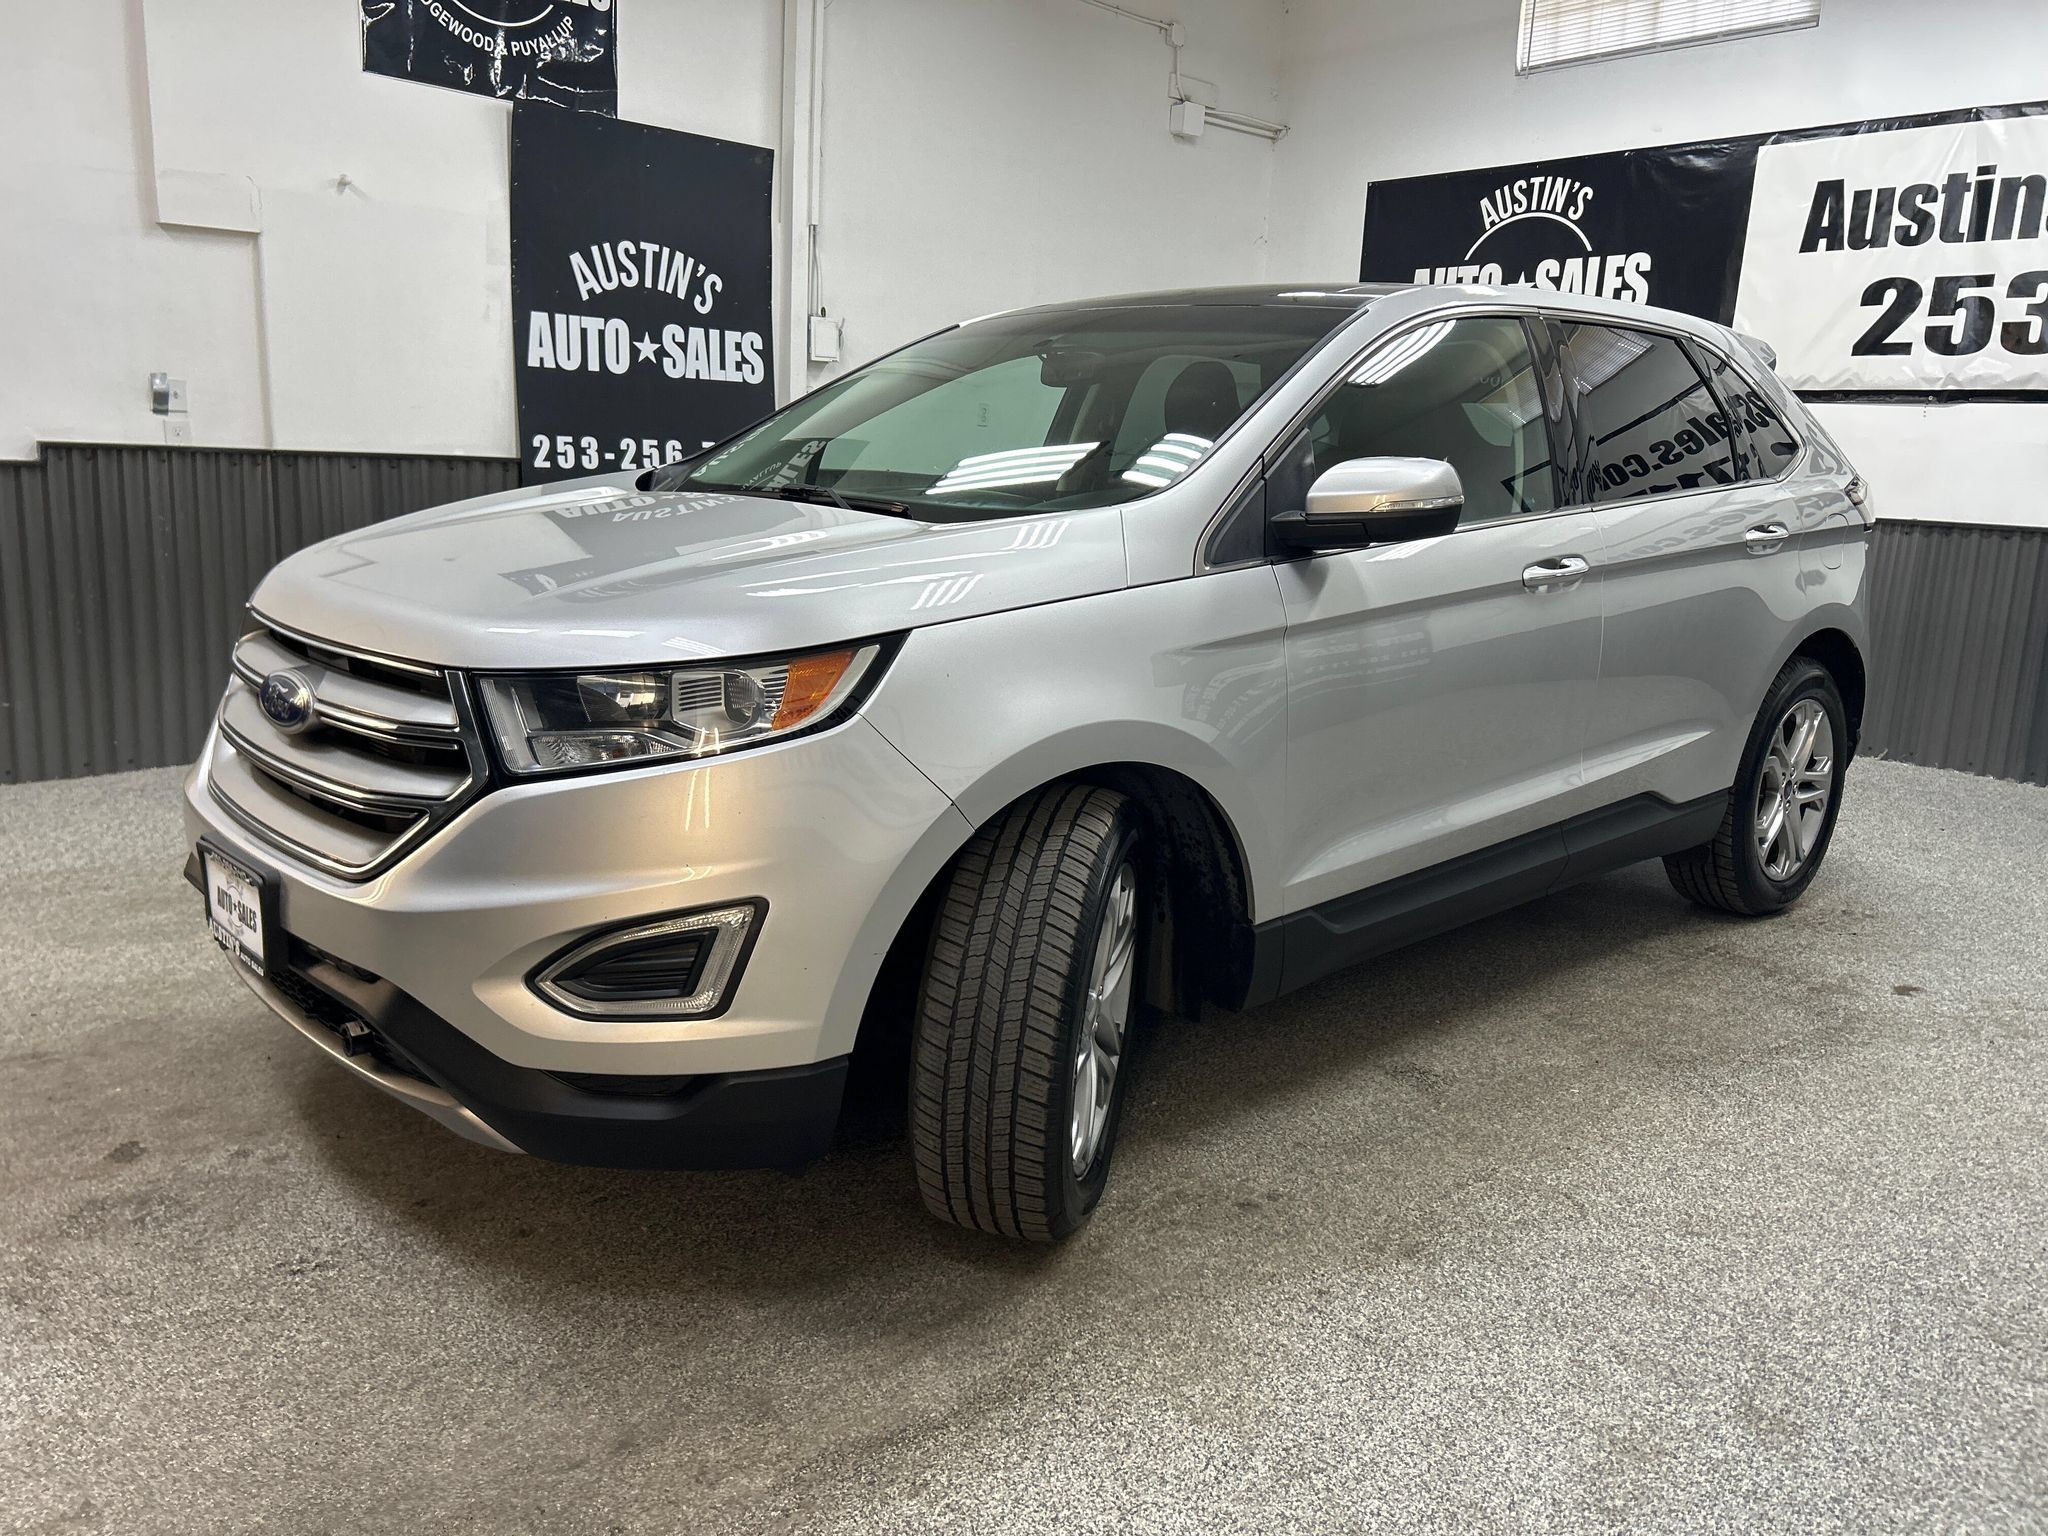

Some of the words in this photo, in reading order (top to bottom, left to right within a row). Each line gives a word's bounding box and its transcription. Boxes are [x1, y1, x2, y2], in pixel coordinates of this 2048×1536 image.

[510, 16, 575, 57] PUYALLUP
[1479, 176, 1594, 230] AUSTIN'S
[1798, 164, 2048, 254] Austin
[568, 240, 723, 315] AUSTIN'S
[1535, 252, 1652, 306] SALES
[1851, 270, 2048, 357] 253
[527, 310, 631, 375] AUTO
[661, 323, 765, 385] SALES
[217, 885, 233, 916] AUTO
[237, 899, 257, 933] SALES
